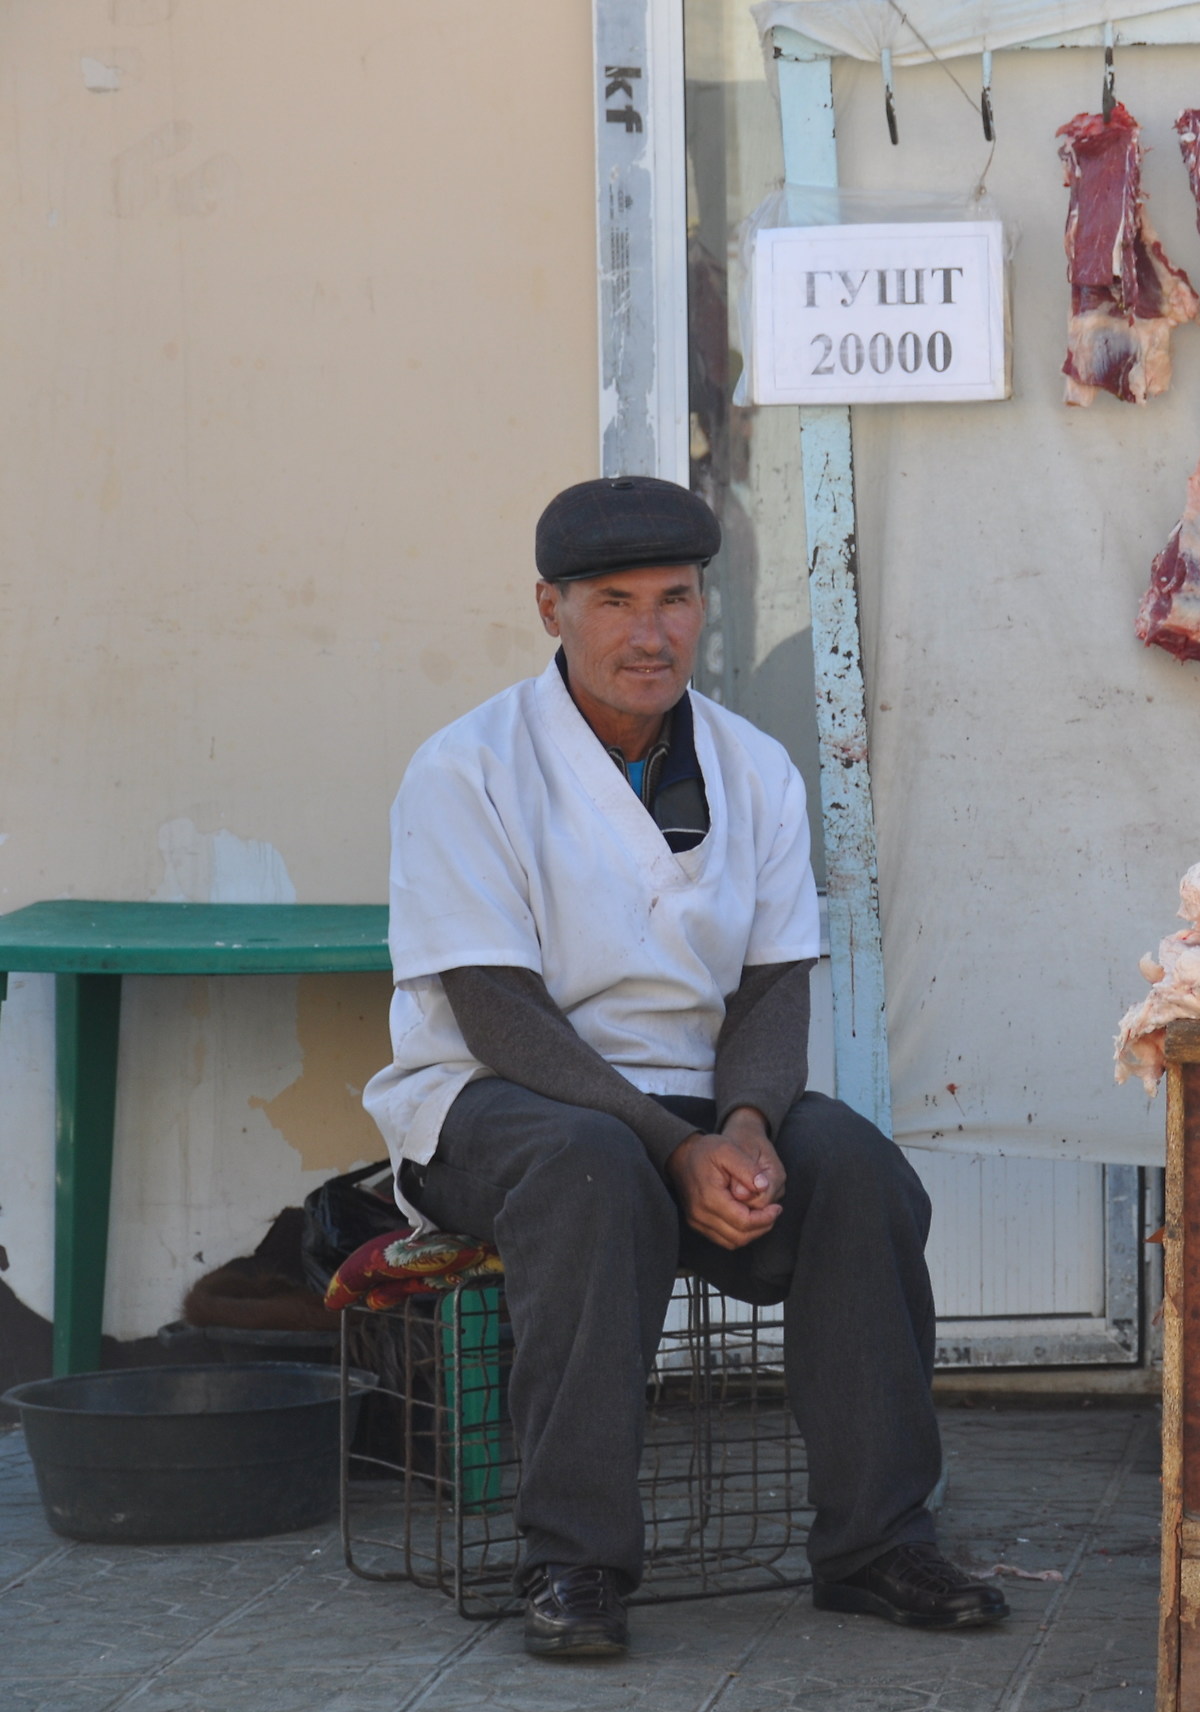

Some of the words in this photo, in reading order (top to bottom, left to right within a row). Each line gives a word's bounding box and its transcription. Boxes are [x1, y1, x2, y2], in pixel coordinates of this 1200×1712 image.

[604, 66, 643, 133] kf
[802, 267, 963, 308] ГУШТ
[810, 330, 952, 375] 20000
